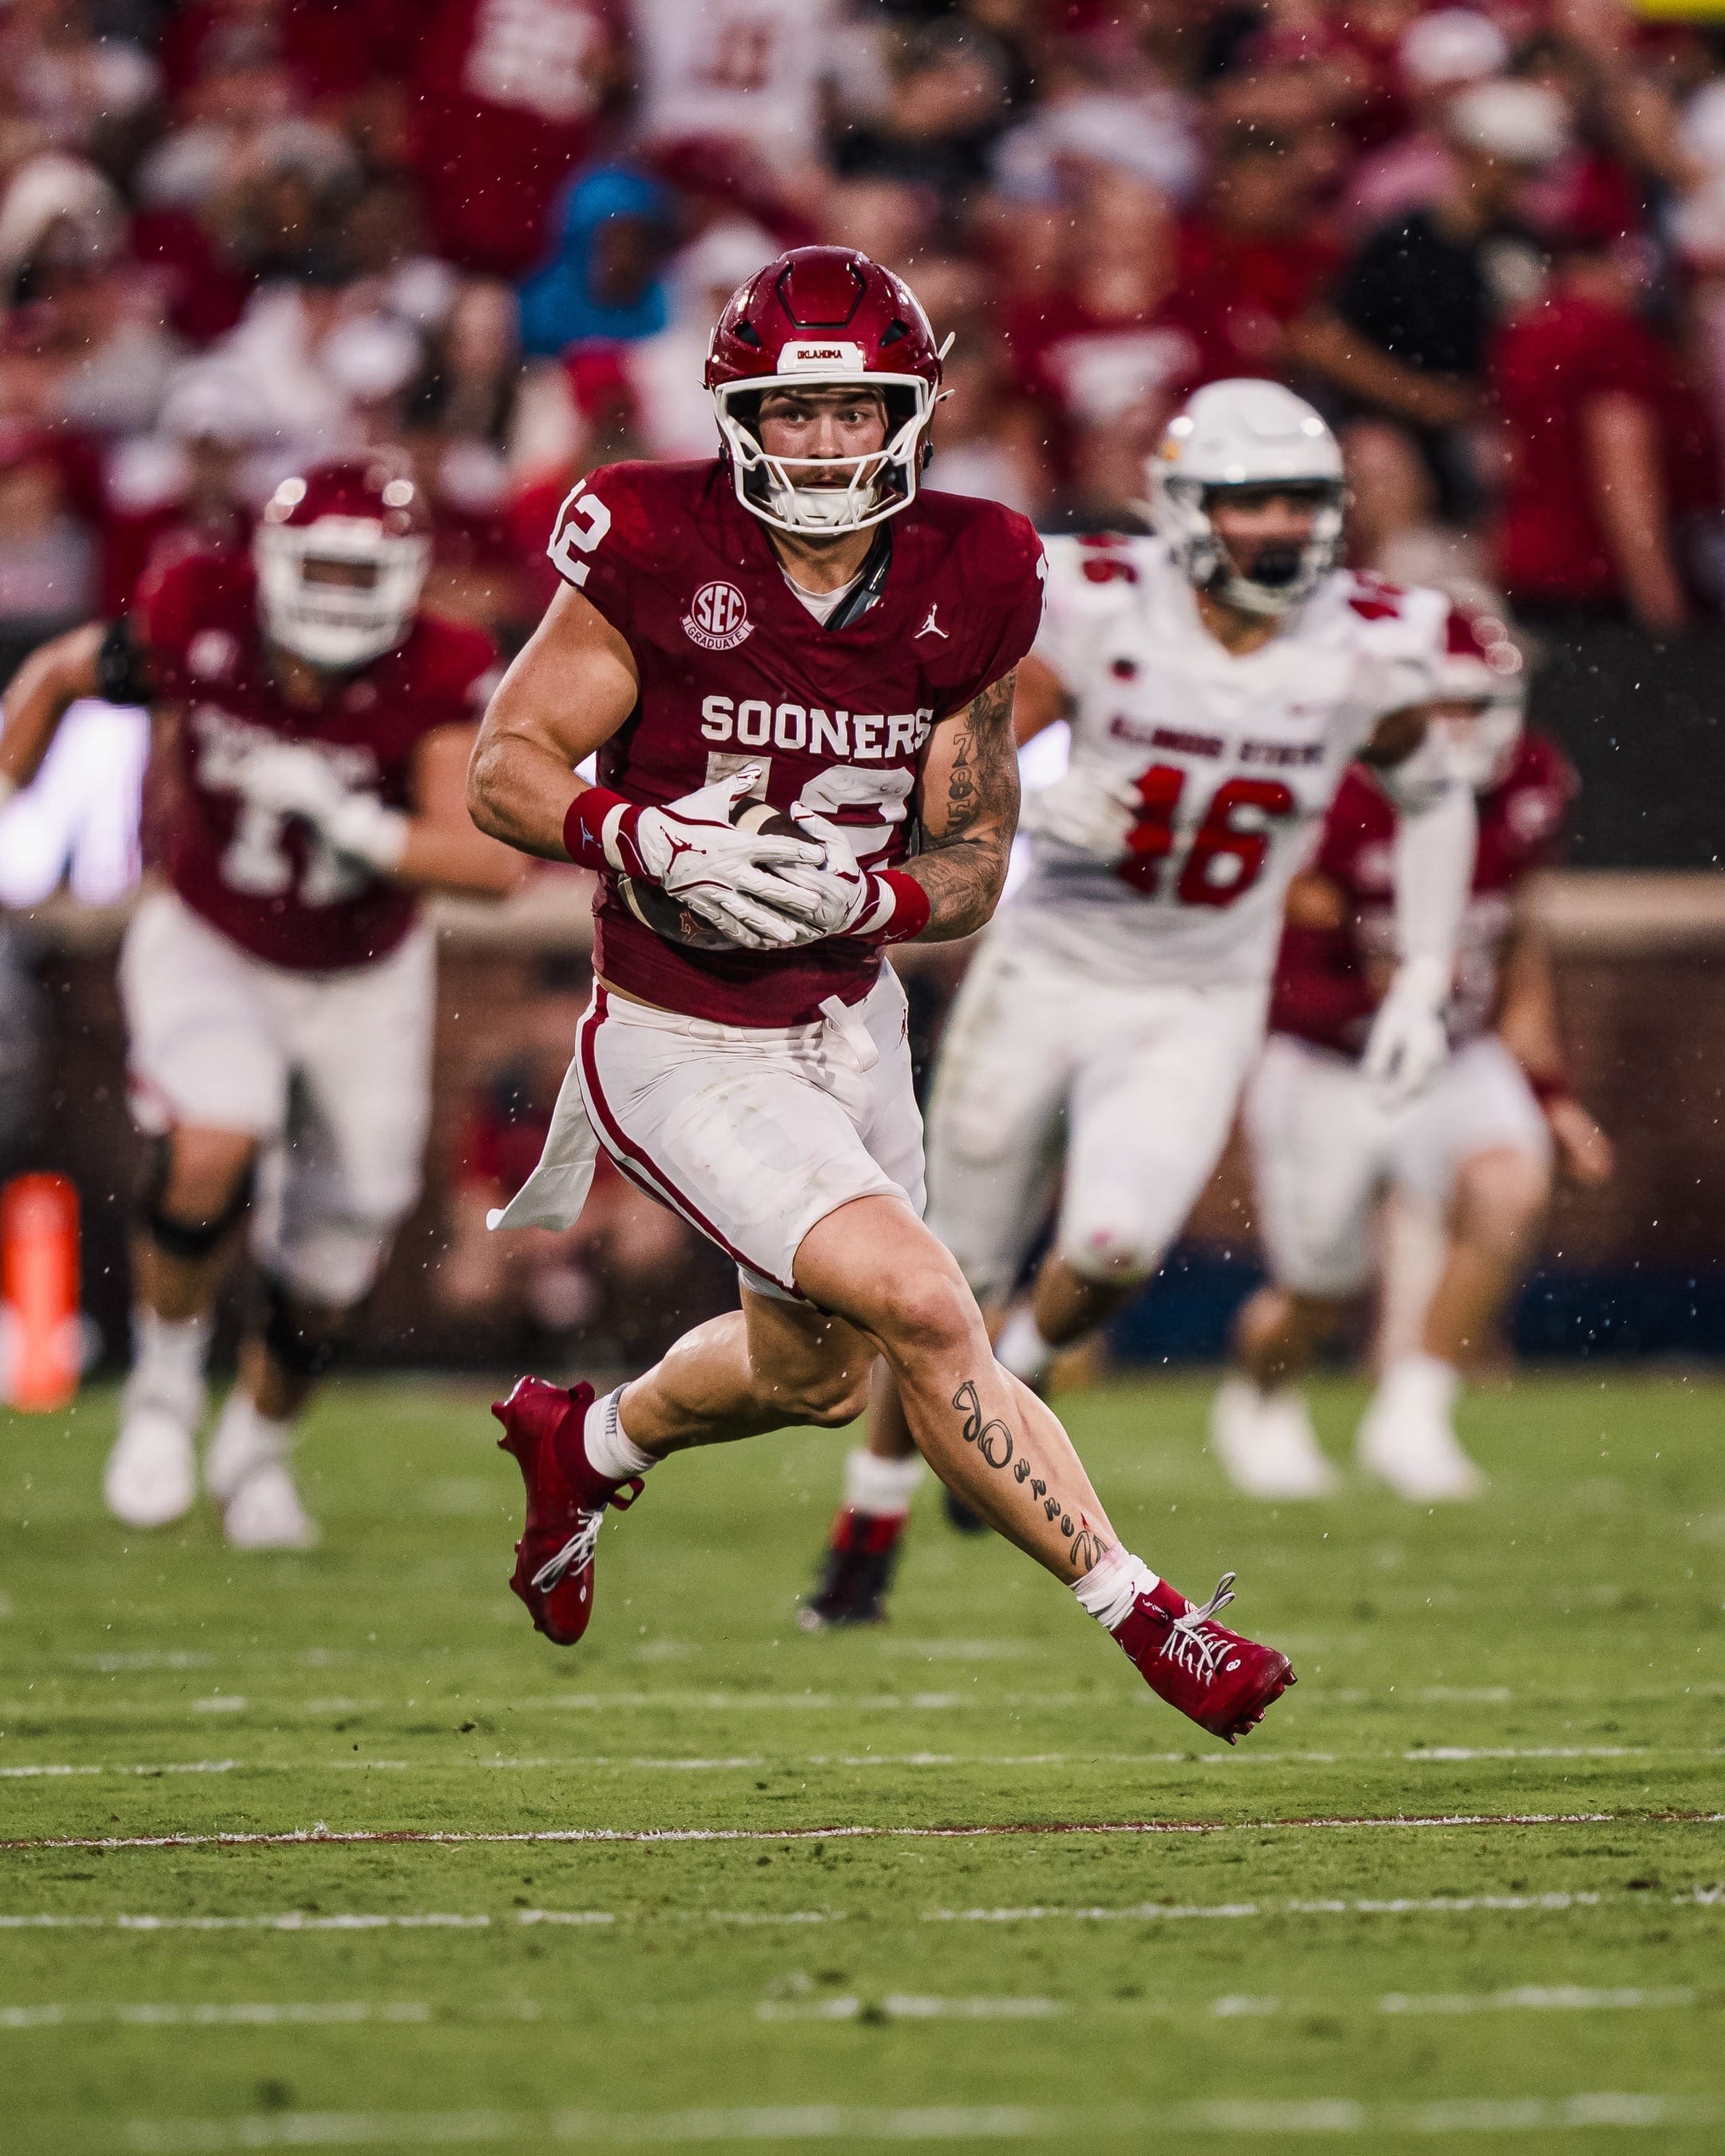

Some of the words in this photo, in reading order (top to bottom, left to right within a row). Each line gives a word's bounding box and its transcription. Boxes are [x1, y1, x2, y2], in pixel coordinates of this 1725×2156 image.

[797, 350, 843, 359] OKLAHOMA
[696, 585, 742, 632] SEC
[687, 626, 744, 649] GRADUATE
[700, 695, 934, 759] SOONERS
